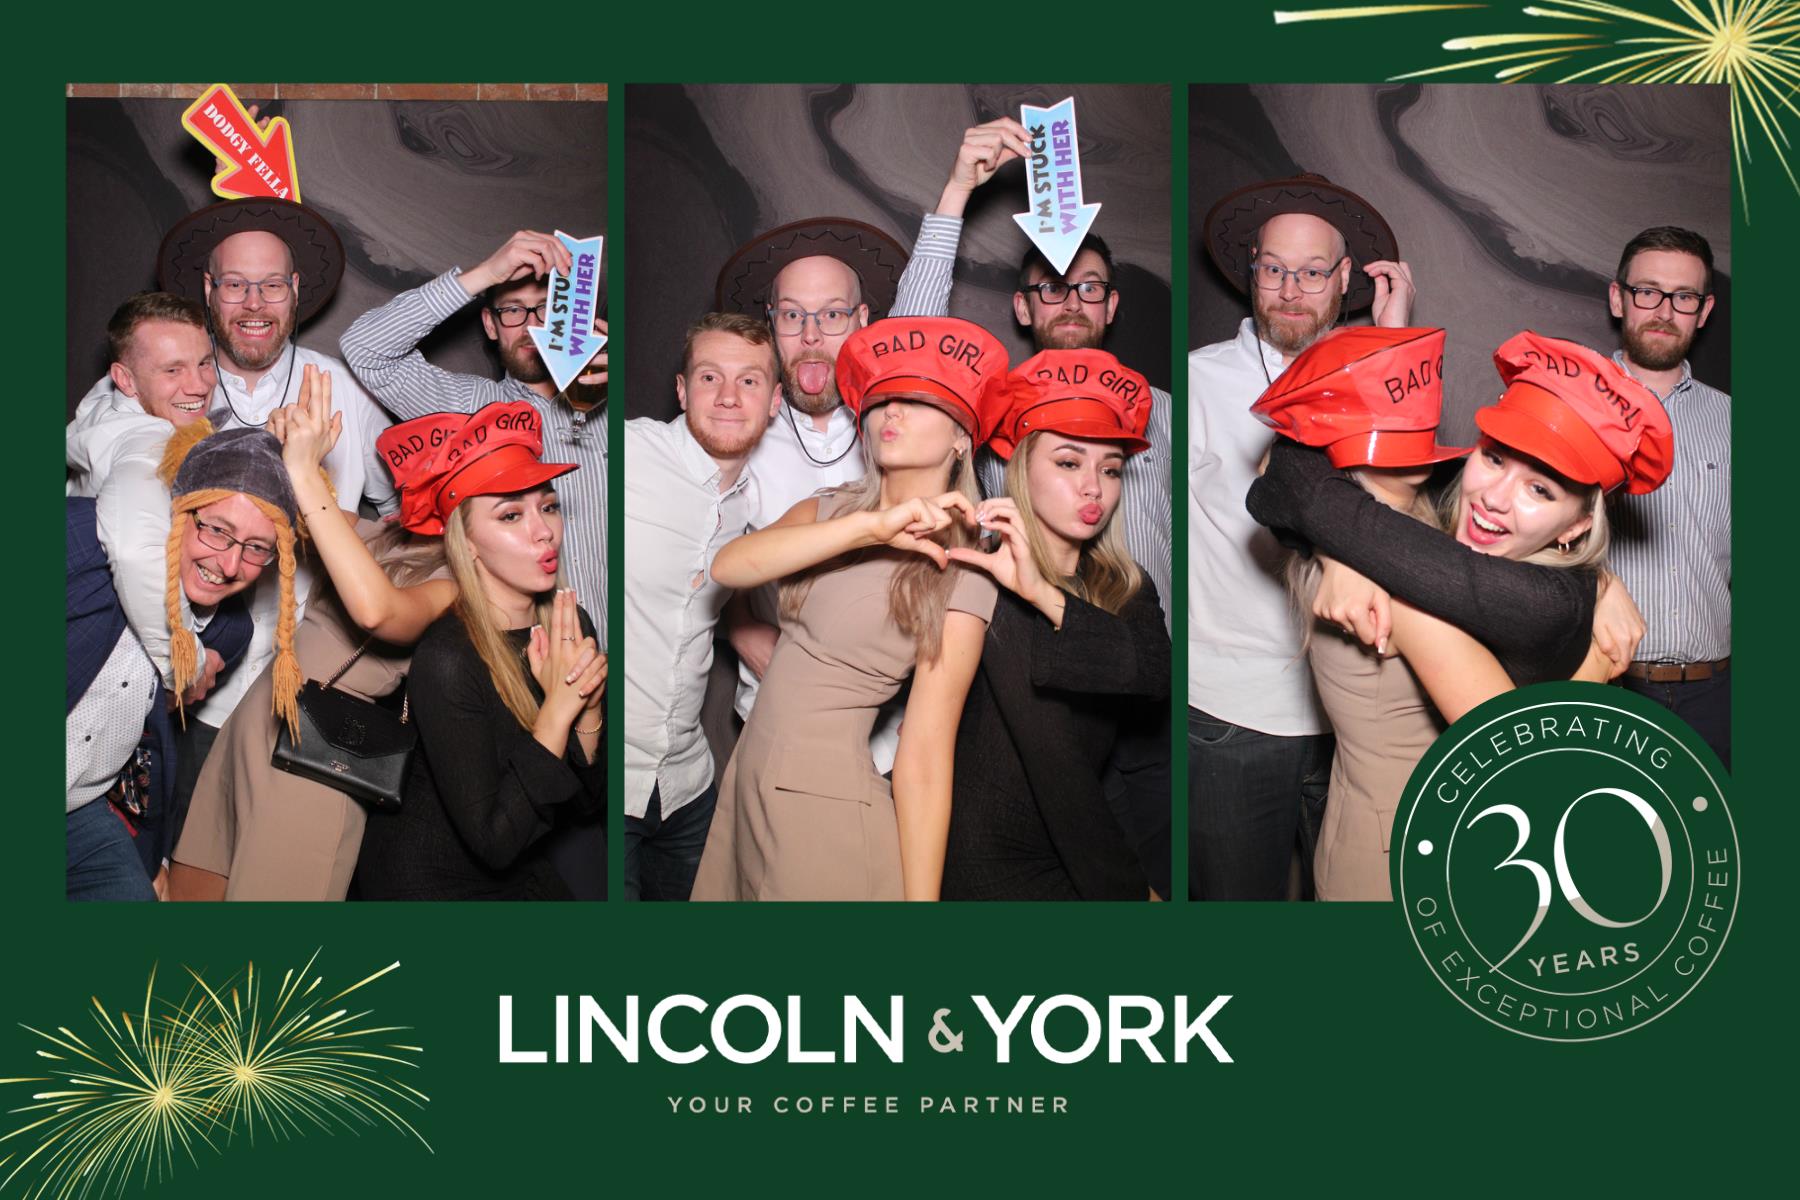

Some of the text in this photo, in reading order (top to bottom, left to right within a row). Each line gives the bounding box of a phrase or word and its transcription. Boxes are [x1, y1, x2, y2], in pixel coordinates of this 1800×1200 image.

[203, 103, 289, 199] DODGY FELLA
[1029, 123, 1055, 233] I'M STUCK
[1051, 119, 1078, 236] WITH HER
[548, 264, 572, 351] I'M STU
[568, 253, 595, 356] WITH HER
[872, 330, 985, 376] BAD GIRL
[1383, 360, 1431, 404] BAD
[388, 434, 424, 468] BAD
[495, 411, 537, 432] GIRL
